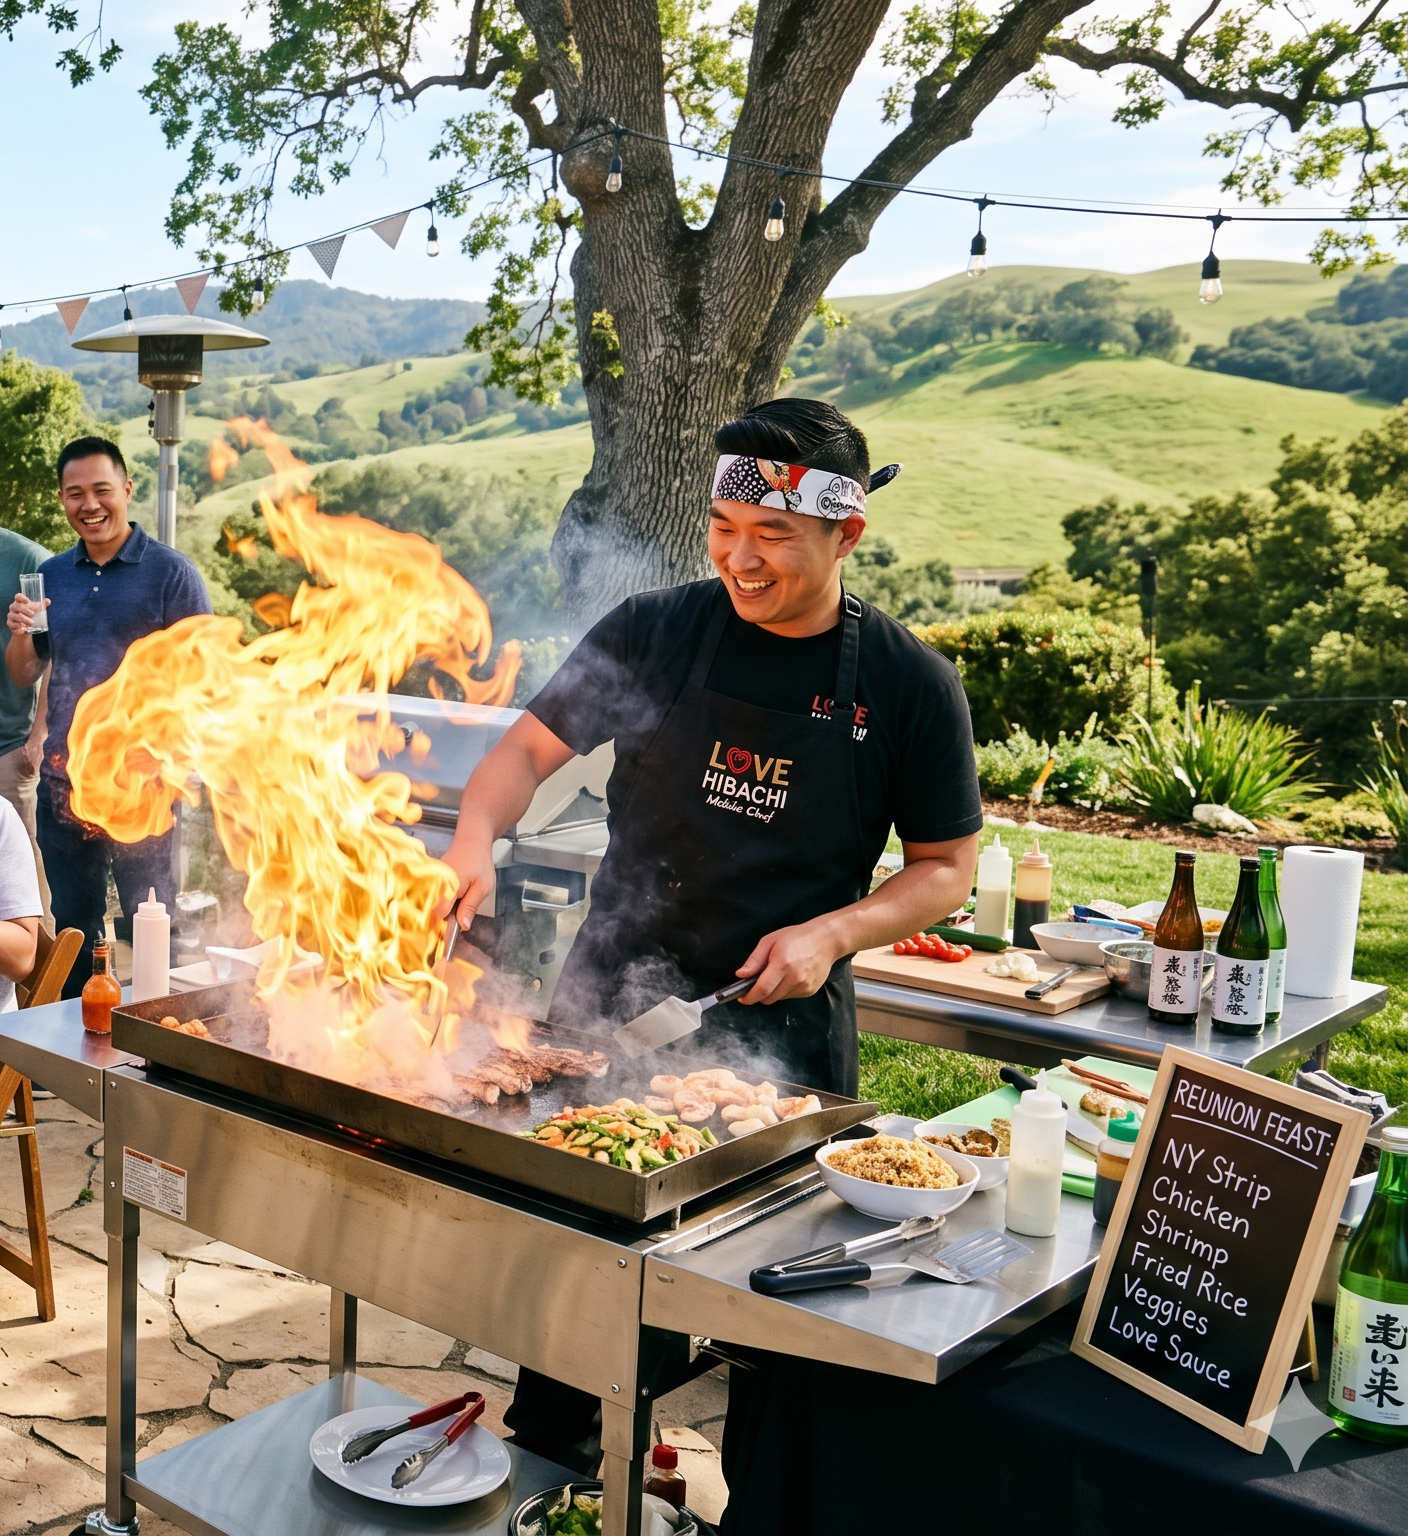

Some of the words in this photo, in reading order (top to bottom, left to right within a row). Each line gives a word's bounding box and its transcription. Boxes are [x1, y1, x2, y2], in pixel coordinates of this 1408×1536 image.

[701, 769, 787, 809] HIBACHI
[1174, 1079, 1261, 1132] REUNION
[1263, 1111, 1335, 1157] FEAST:
[1162, 1138, 1205, 1174] NY
[1206, 1155, 1272, 1209] Strip
[1141, 1209, 1229, 1270] Shrimp
[1152, 1176, 1250, 1238] Chicken
[1124, 1273, 1209, 1335] Veggies
[1131, 1241, 1192, 1290] Fried
[1196, 1270, 1248, 1316] Rice
[1109, 1305, 1158, 1352] Love
[1164, 1334, 1231, 1388] Sauce
